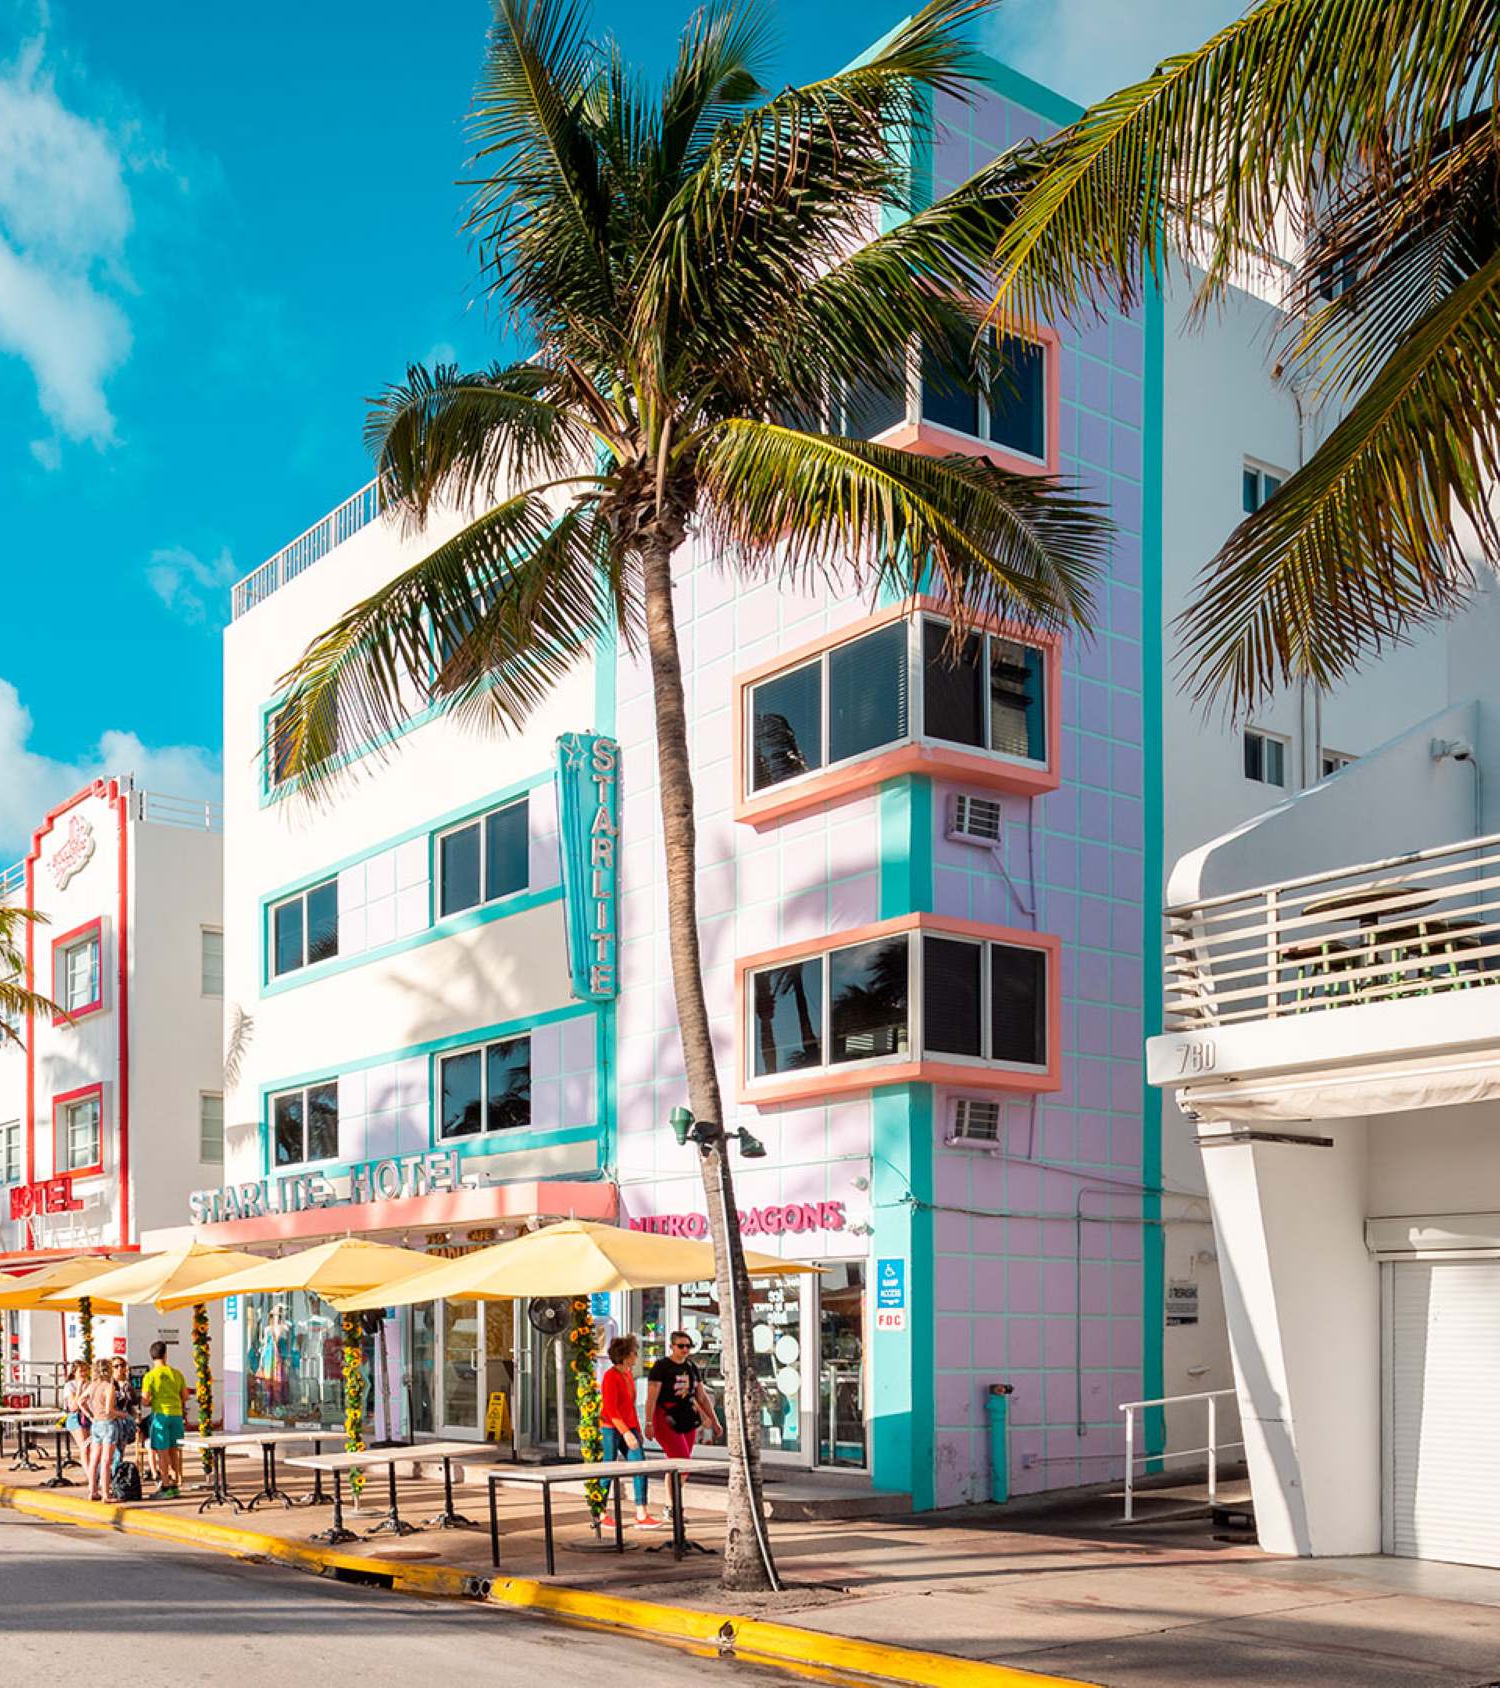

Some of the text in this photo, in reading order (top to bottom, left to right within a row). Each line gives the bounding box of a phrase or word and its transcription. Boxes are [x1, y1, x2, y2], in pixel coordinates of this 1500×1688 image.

[590, 737, 616, 995] STARLITE
[10, 1177, 85, 1220] HOTEL
[189, 1150, 477, 1225] STARLITE HOTEL
[629, 1212, 706, 1237] NITRO
[737, 1200, 845, 1236] RAGONS
[878, 1314, 901, 1326] FDC
